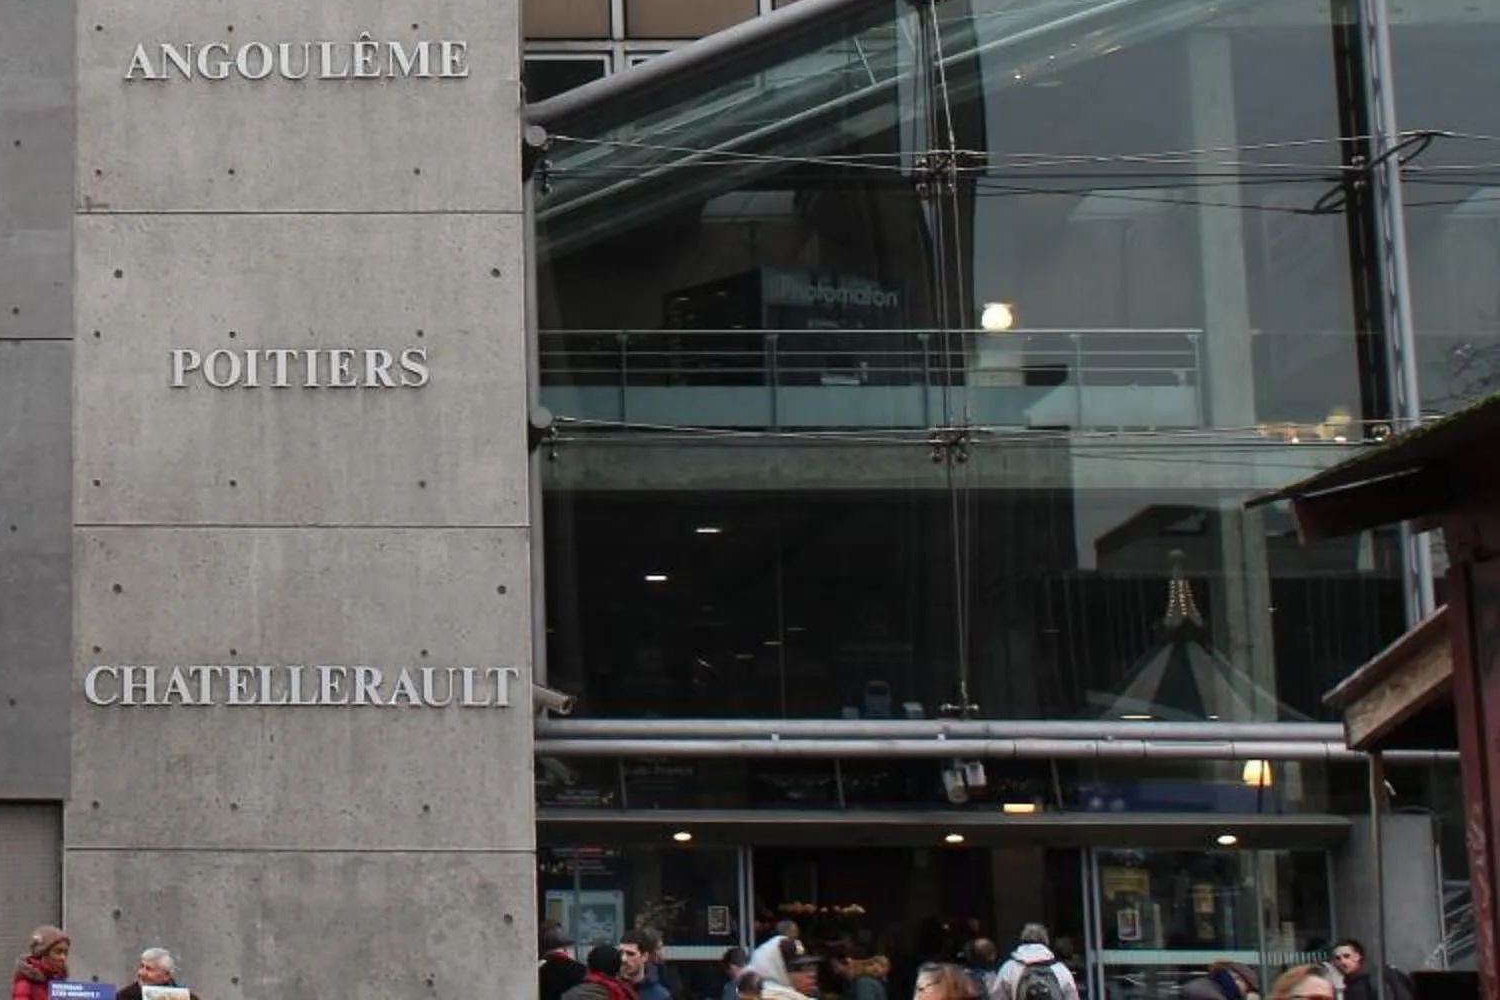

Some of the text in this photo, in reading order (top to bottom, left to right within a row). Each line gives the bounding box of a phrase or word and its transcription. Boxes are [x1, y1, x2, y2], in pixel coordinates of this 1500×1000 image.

[125, 32, 469, 80] ANGOULÊME
[172, 349, 430, 387] POITIERS
[84, 666, 518, 706] CHATELLERAULT
